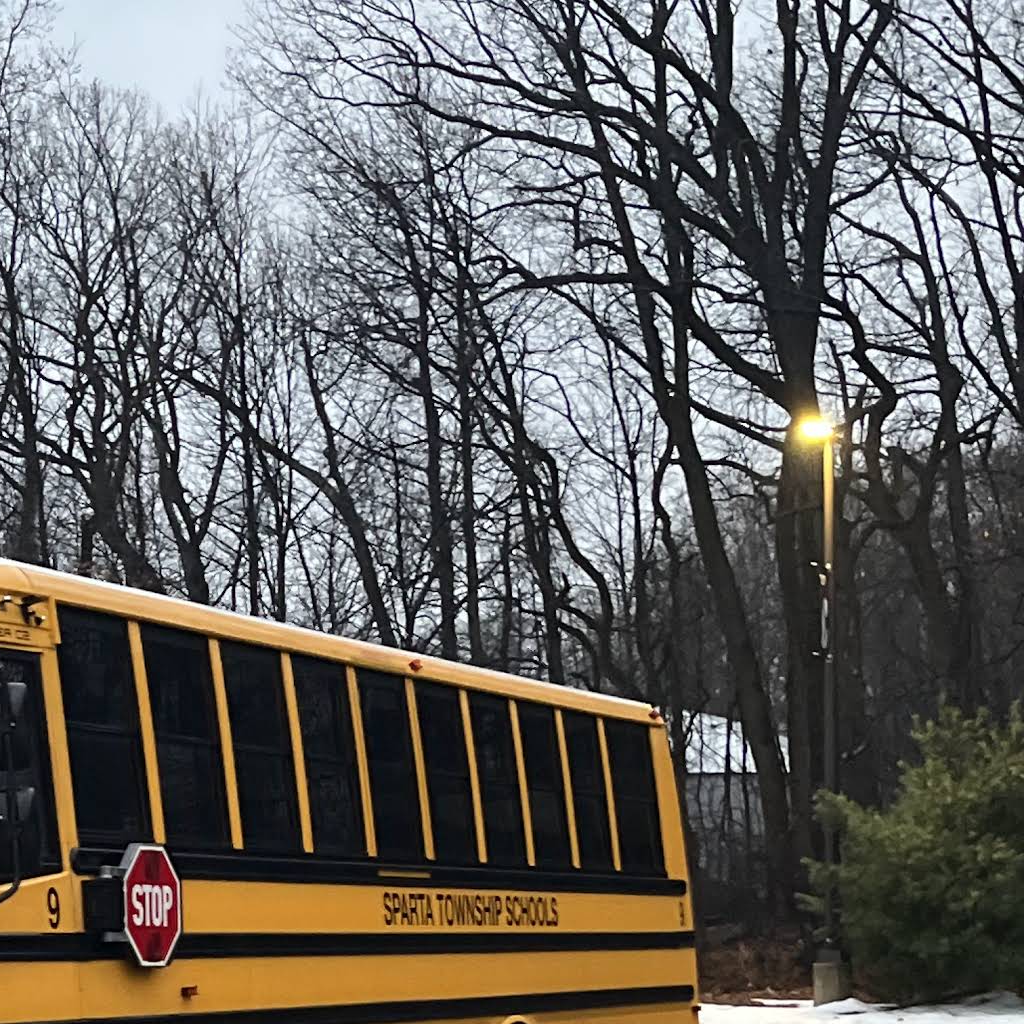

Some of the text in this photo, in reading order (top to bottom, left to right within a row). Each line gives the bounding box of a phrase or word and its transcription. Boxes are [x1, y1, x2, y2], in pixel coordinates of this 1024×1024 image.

[47, 887, 60, 929] 9
[131, 884, 173, 927] STOP
[383, 892, 559, 927] SPARTA TOWNSHIP SCHOOLS
